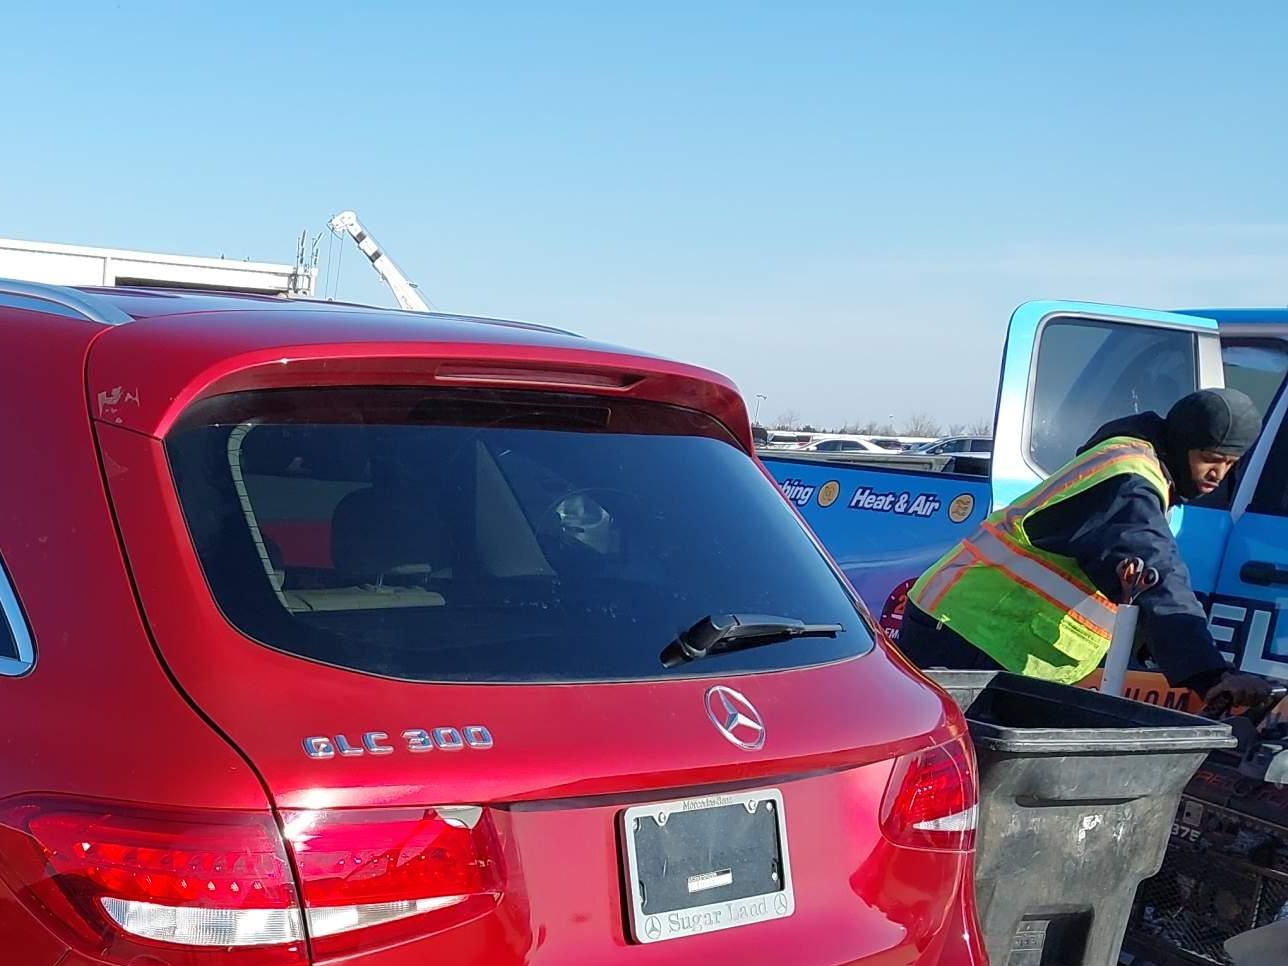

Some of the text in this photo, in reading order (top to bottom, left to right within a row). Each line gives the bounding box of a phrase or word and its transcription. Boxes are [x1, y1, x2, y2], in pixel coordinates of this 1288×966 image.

[779, 480, 940, 516] bing Heat & Air
[303, 726, 494, 759] GLC 300
[668, 901, 769, 934] Sugar Land
